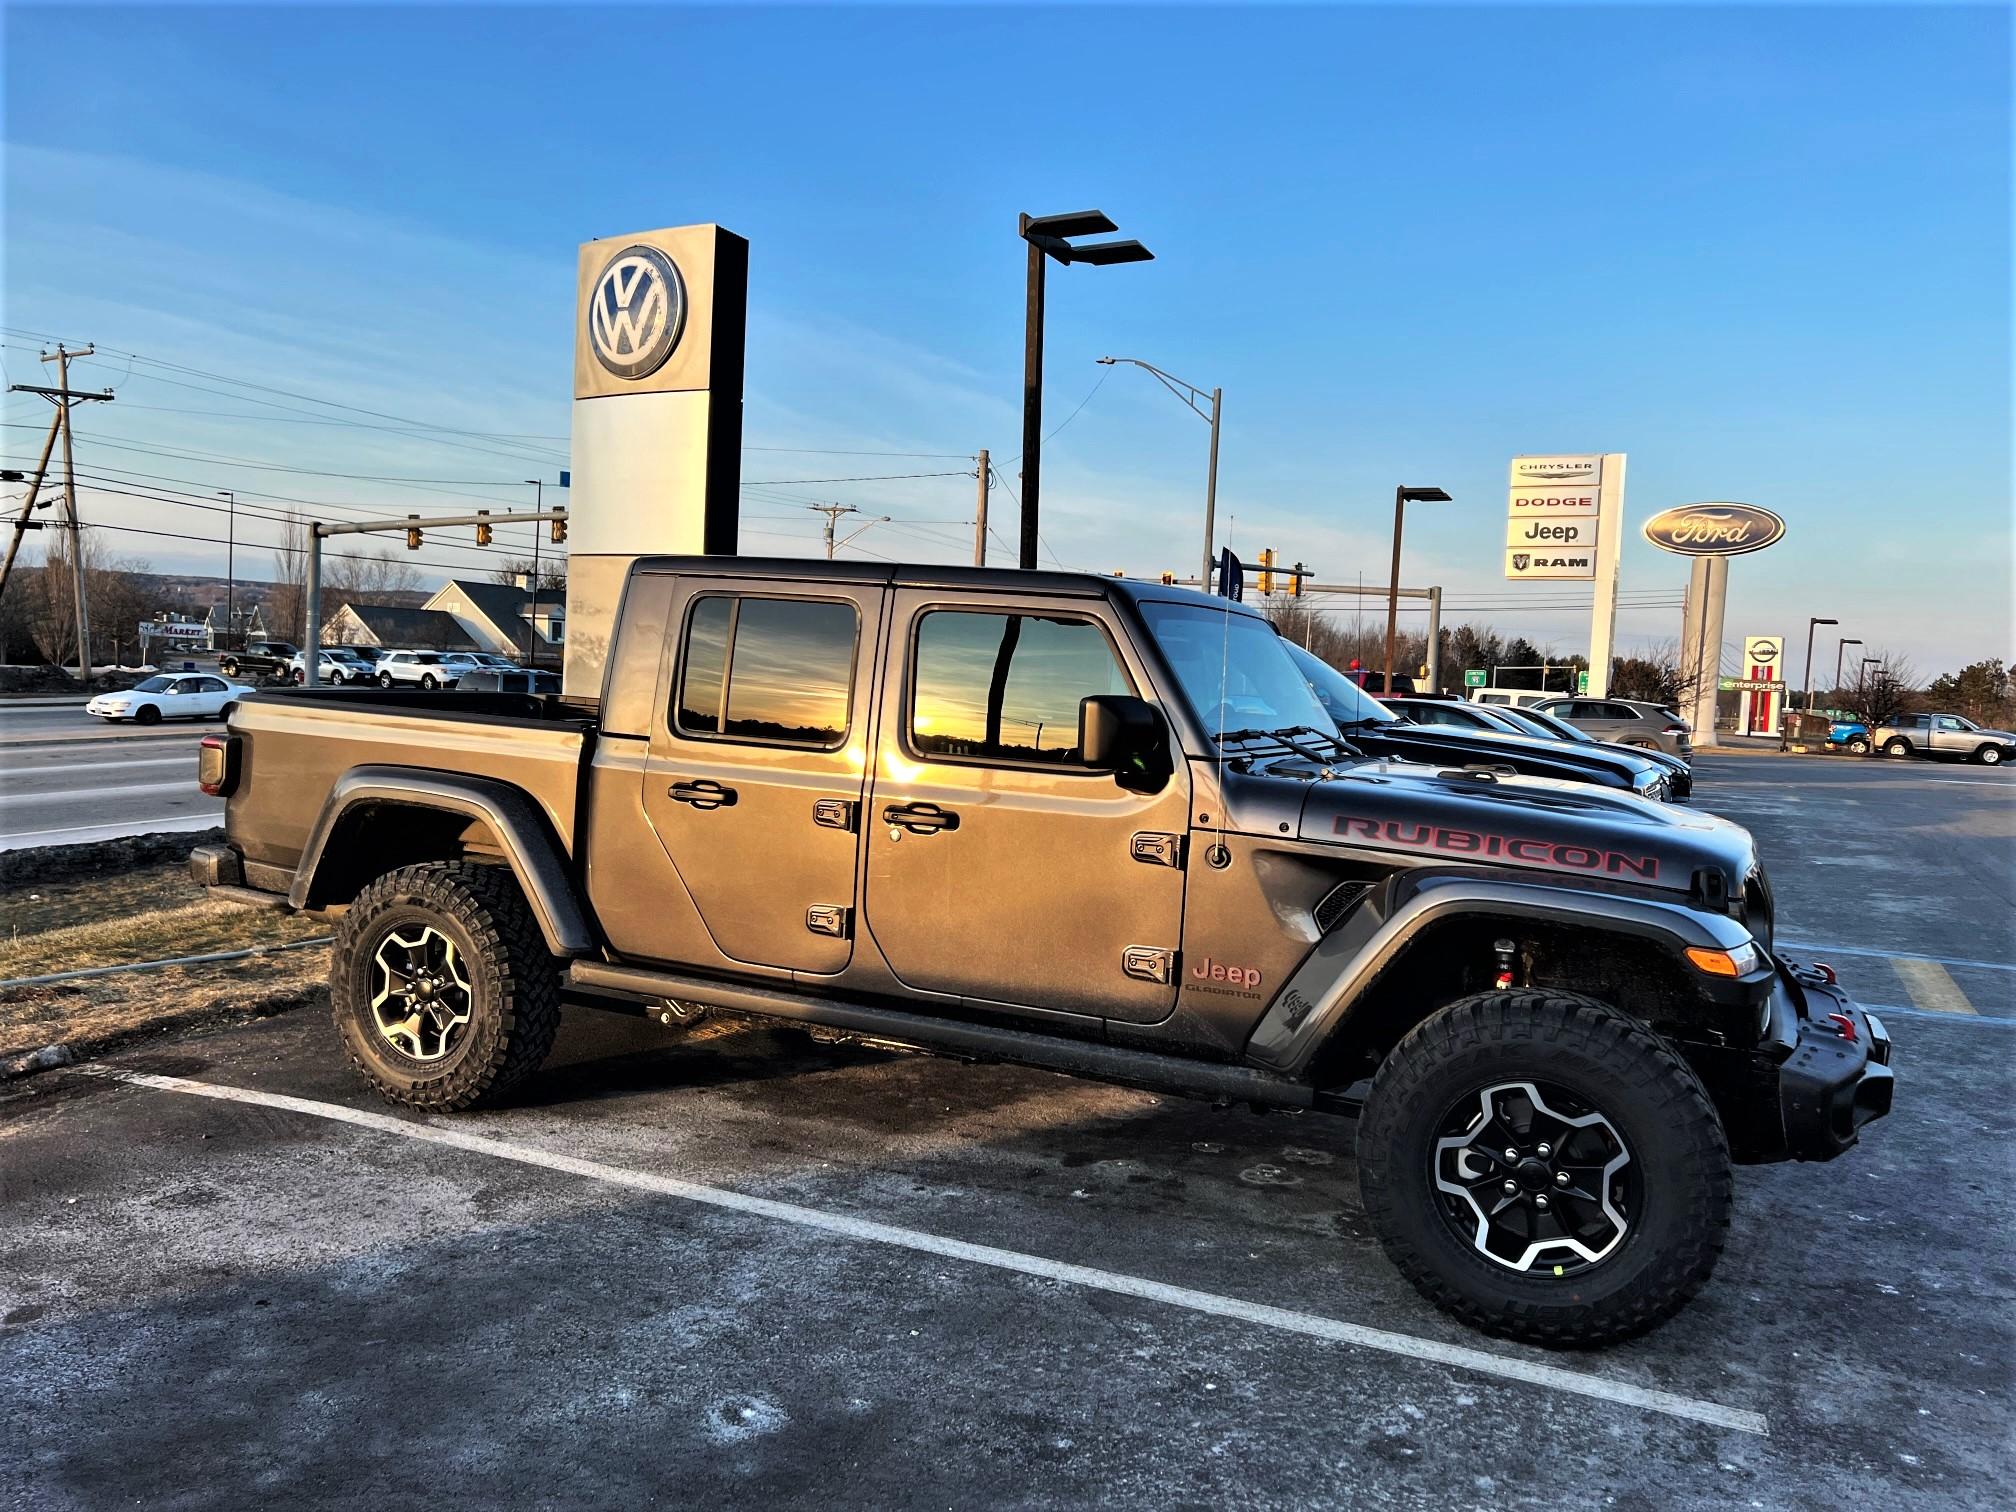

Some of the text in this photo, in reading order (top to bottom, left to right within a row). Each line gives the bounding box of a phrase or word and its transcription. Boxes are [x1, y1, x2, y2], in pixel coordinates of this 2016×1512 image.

[1515, 497, 1593, 507] DODGE
[1525, 522, 1579, 543] Jeep
[1671, 513, 1753, 543] Ford
[1533, 558, 1589, 567] RAM
[1722, 681, 1785, 690] enterprise
[1332, 814, 1660, 880] RUBICON
[1192, 957, 1263, 990] Jeep
[1185, 983, 1262, 1000] GLADIATOR
